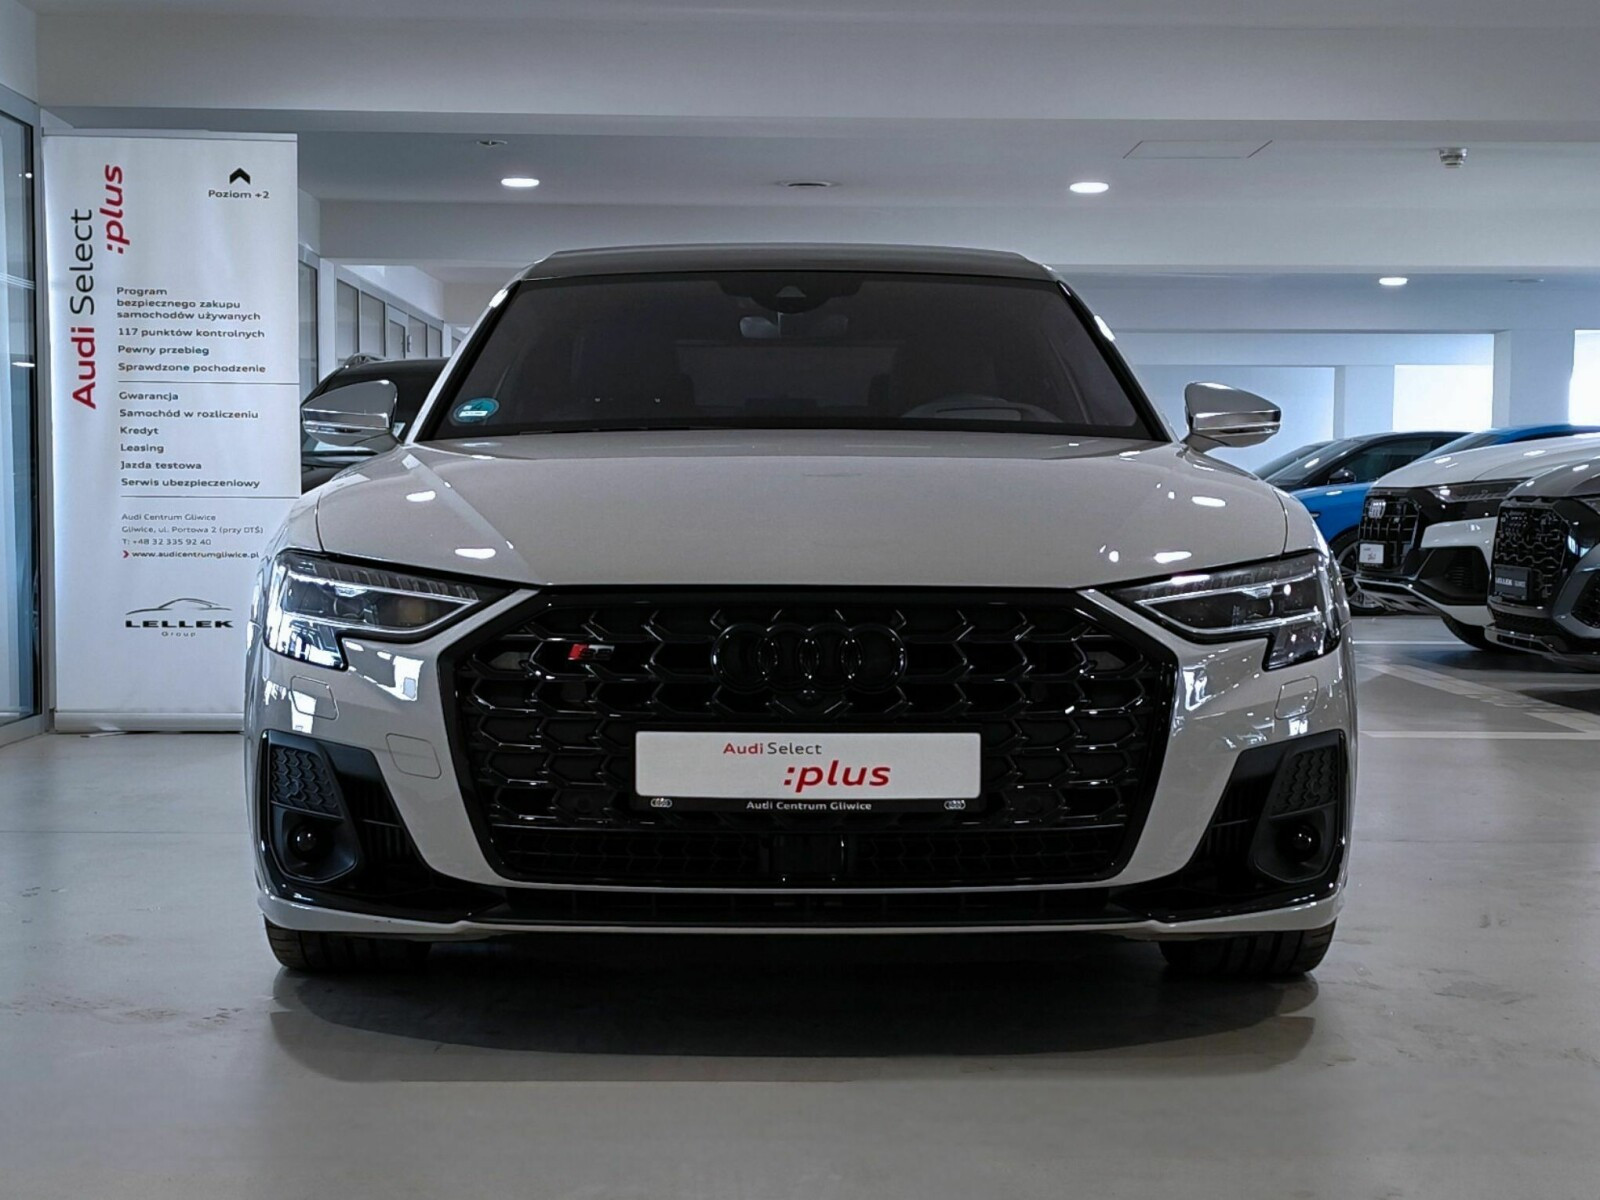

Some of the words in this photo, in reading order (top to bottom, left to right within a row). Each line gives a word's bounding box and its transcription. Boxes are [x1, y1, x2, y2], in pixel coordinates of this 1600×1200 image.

[208, 189, 252, 199] Poziom
[254, 190, 270, 200] +2
[99, 164, 130, 254] :plus
[68, 208, 95, 316] Select
[116, 286, 168, 298] Program
[116, 298, 196, 310] bezpiecznego
[199, 300, 241, 310] zakupu
[116, 310, 195, 321] samochodów
[197, 310, 261, 322] używanych
[118, 327, 138, 337] 117
[140, 327, 193, 339] punktów
[195, 328, 265, 340] kontrolnych
[117, 344, 155, 356] Pewny
[159, 345, 210, 357] przebieg
[70, 326, 97, 410] Audi
[117, 362, 190, 374] Sprawdzone
[192, 363, 267, 375] pochodzenie
[118, 391, 179, 402] Gwarancja
[119, 408, 181, 419] Samochód
[183, 411, 194, 419] w
[196, 409, 259, 419] rozliczeniu
[119, 426, 159, 437] Kredyt
[120, 443, 165, 455] Leasing
[120, 460, 152, 470] Jazda
[155, 461, 202, 470] testowa
[120, 477, 159, 487] Serwis
[162, 478, 261, 490] ubezpieczeniowy
[121, 513, 142, 522] Audi
[143, 513, 183, 522] Centrum
[184, 514, 217, 522] Gliwice
[121, 525, 157, 535] Gliwice,
[171, 526, 209, 535] Portowa
[211, 526, 218, 534] 2
[219, 526, 242, 536] (przy
[122, 538, 131, 546] T:
[132, 538, 150, 546] +48
[152, 538, 164, 546] 32
[131, 550, 260, 560] www.audicentrumgliwice.pl
[125, 619, 234, 629] LELLEK
[160, 631, 197, 639] Group
[722, 742, 764, 755] Audi
[767, 741, 823, 756] Select
[783, 760, 891, 793] :plus
[746, 801, 773, 811] Audi
[776, 801, 827, 811] Centrum
[829, 801, 872, 811] Gliwice
